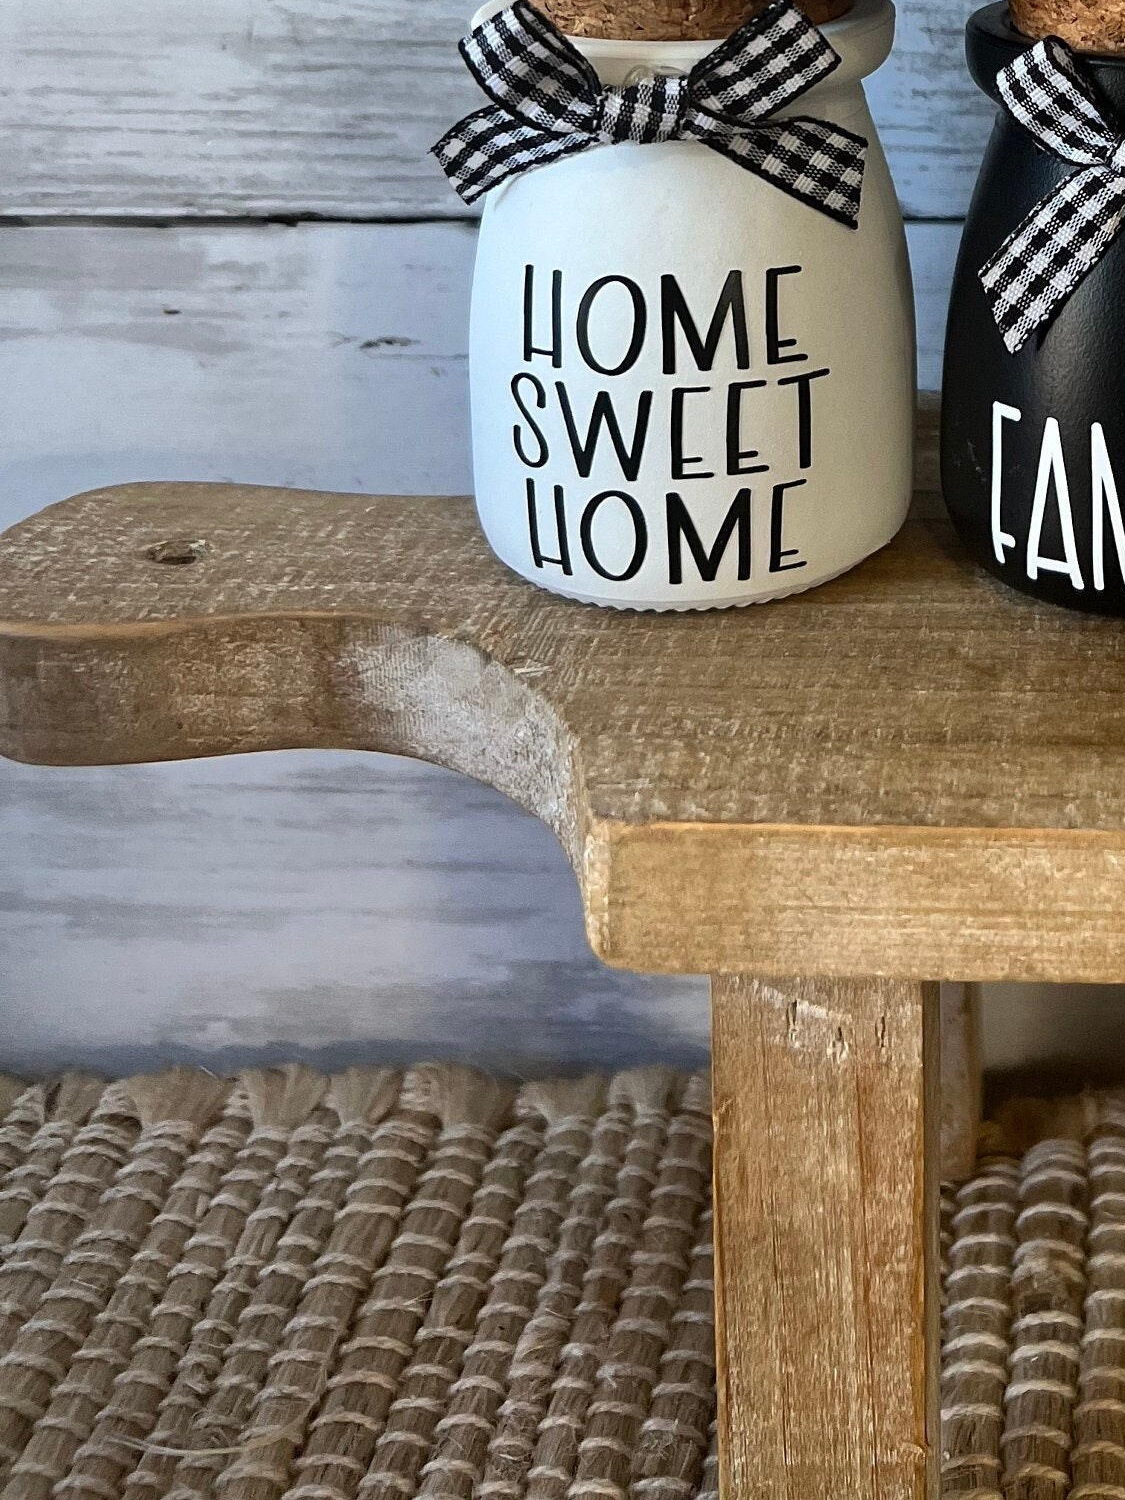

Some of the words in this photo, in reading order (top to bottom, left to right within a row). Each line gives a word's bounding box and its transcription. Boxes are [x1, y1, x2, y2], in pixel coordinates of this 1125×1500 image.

[523, 264, 809, 377] HOME
[510, 368, 831, 482] SWEET
[526, 477, 808, 585] HOME
